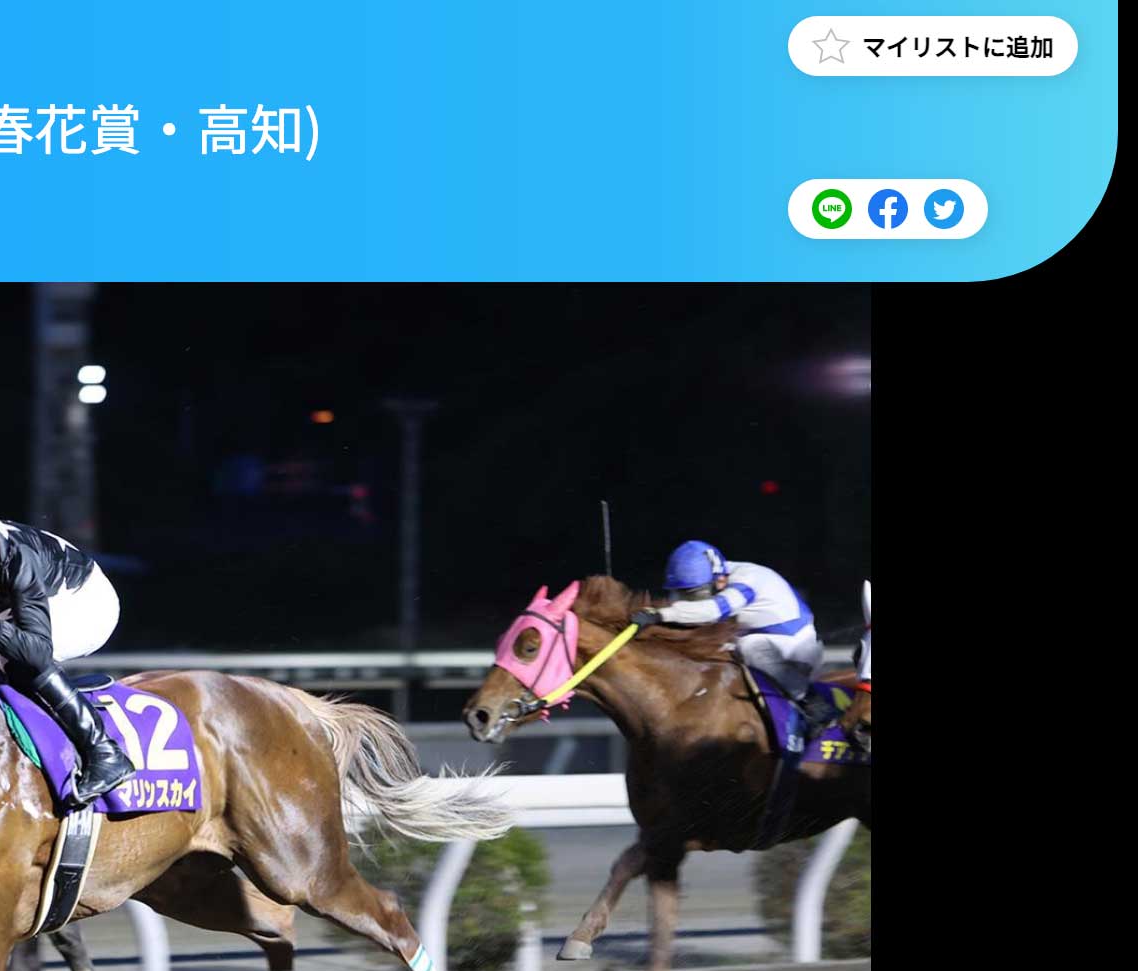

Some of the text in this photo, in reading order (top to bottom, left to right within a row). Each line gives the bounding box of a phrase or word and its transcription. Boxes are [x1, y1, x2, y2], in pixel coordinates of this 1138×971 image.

[97, 694, 190, 771] 12
[117, 778, 197, 808] マリンスカイ
